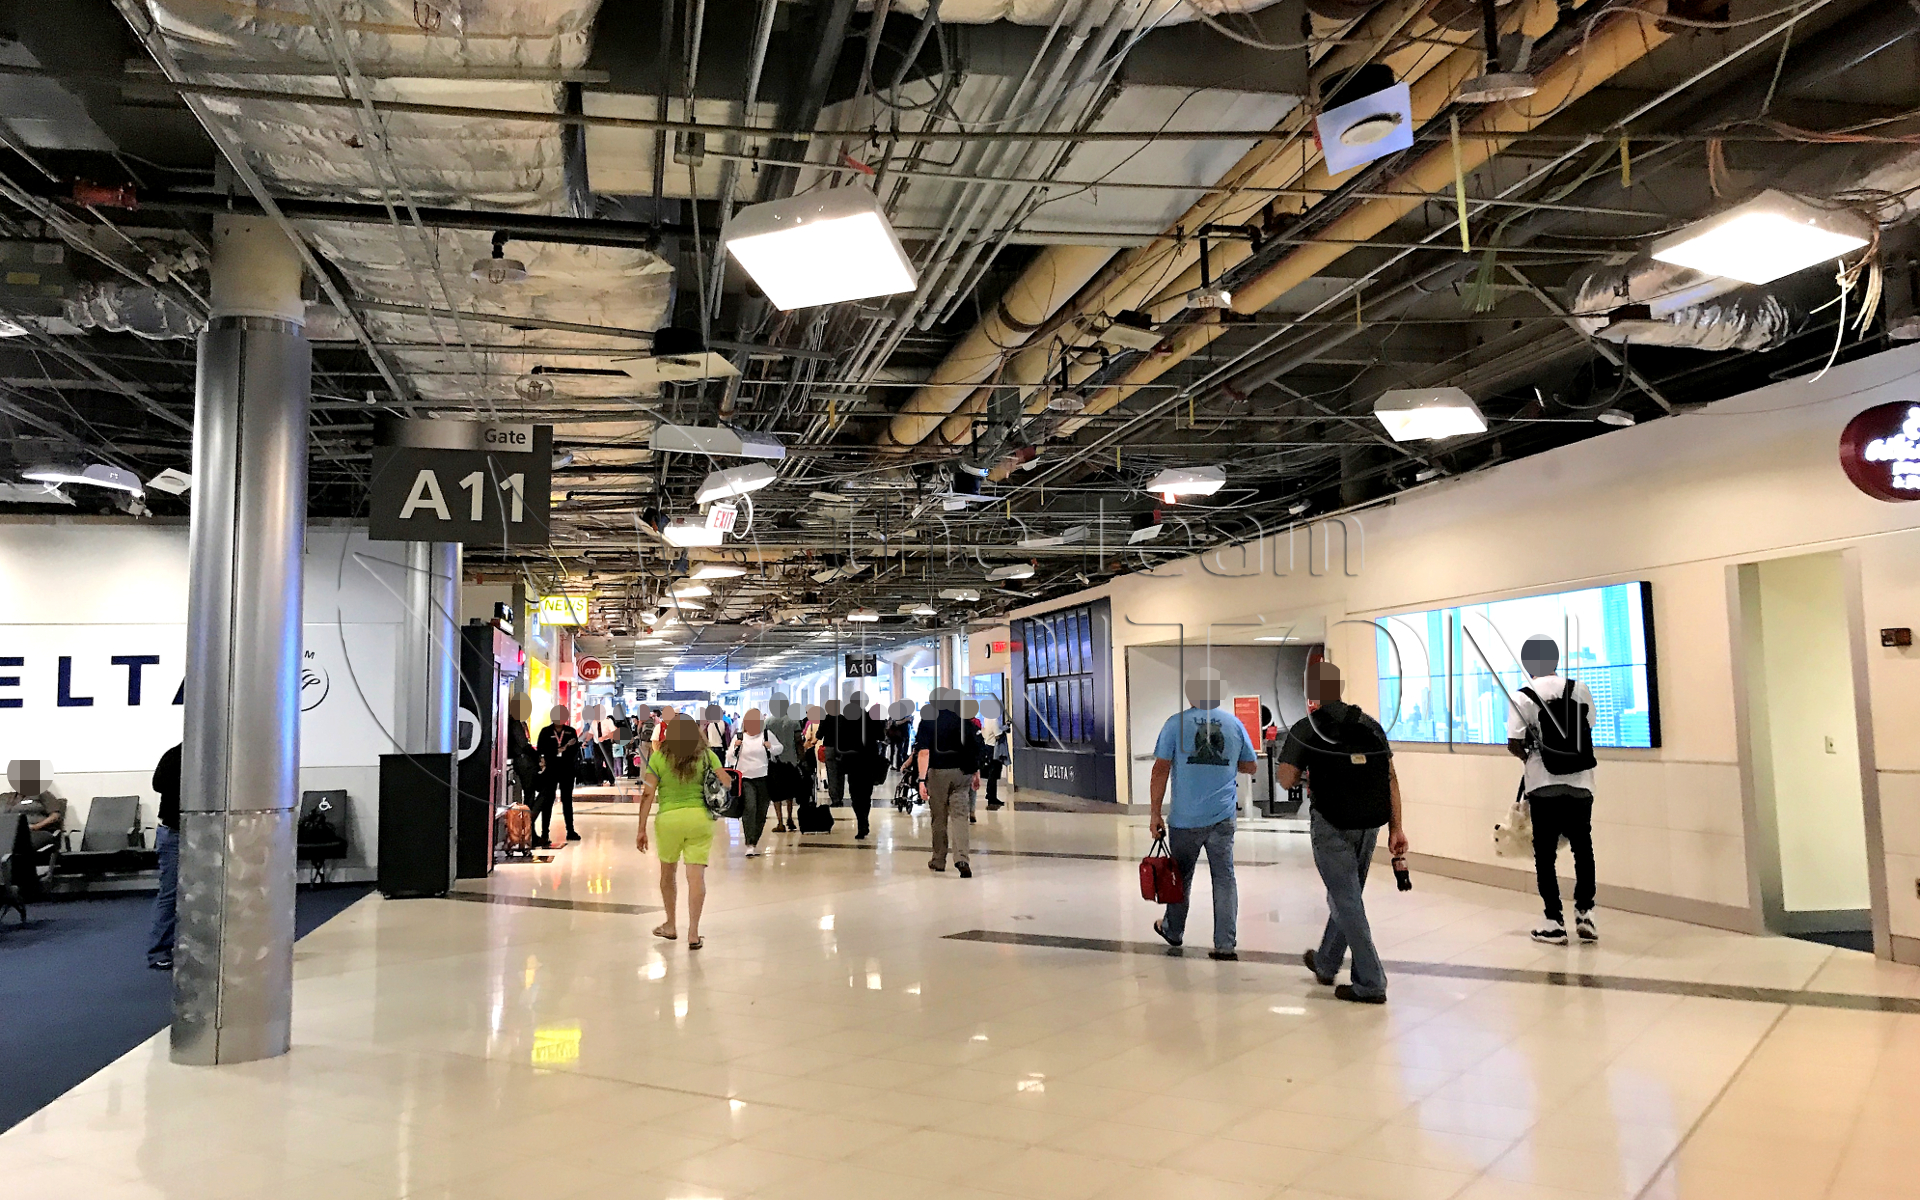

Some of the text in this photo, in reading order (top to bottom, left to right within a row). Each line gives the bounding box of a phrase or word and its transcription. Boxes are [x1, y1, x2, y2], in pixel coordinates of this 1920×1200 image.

[484, 428, 527, 445] Gate
[398, 469, 526, 523] A11
[713, 510, 735, 529] EXIT
[544, 599, 584, 611] NEWS
[849, 663, 873, 674] A10
[0, 655, 186, 708] ELT
[1049, 765, 1069, 780] DELTA
